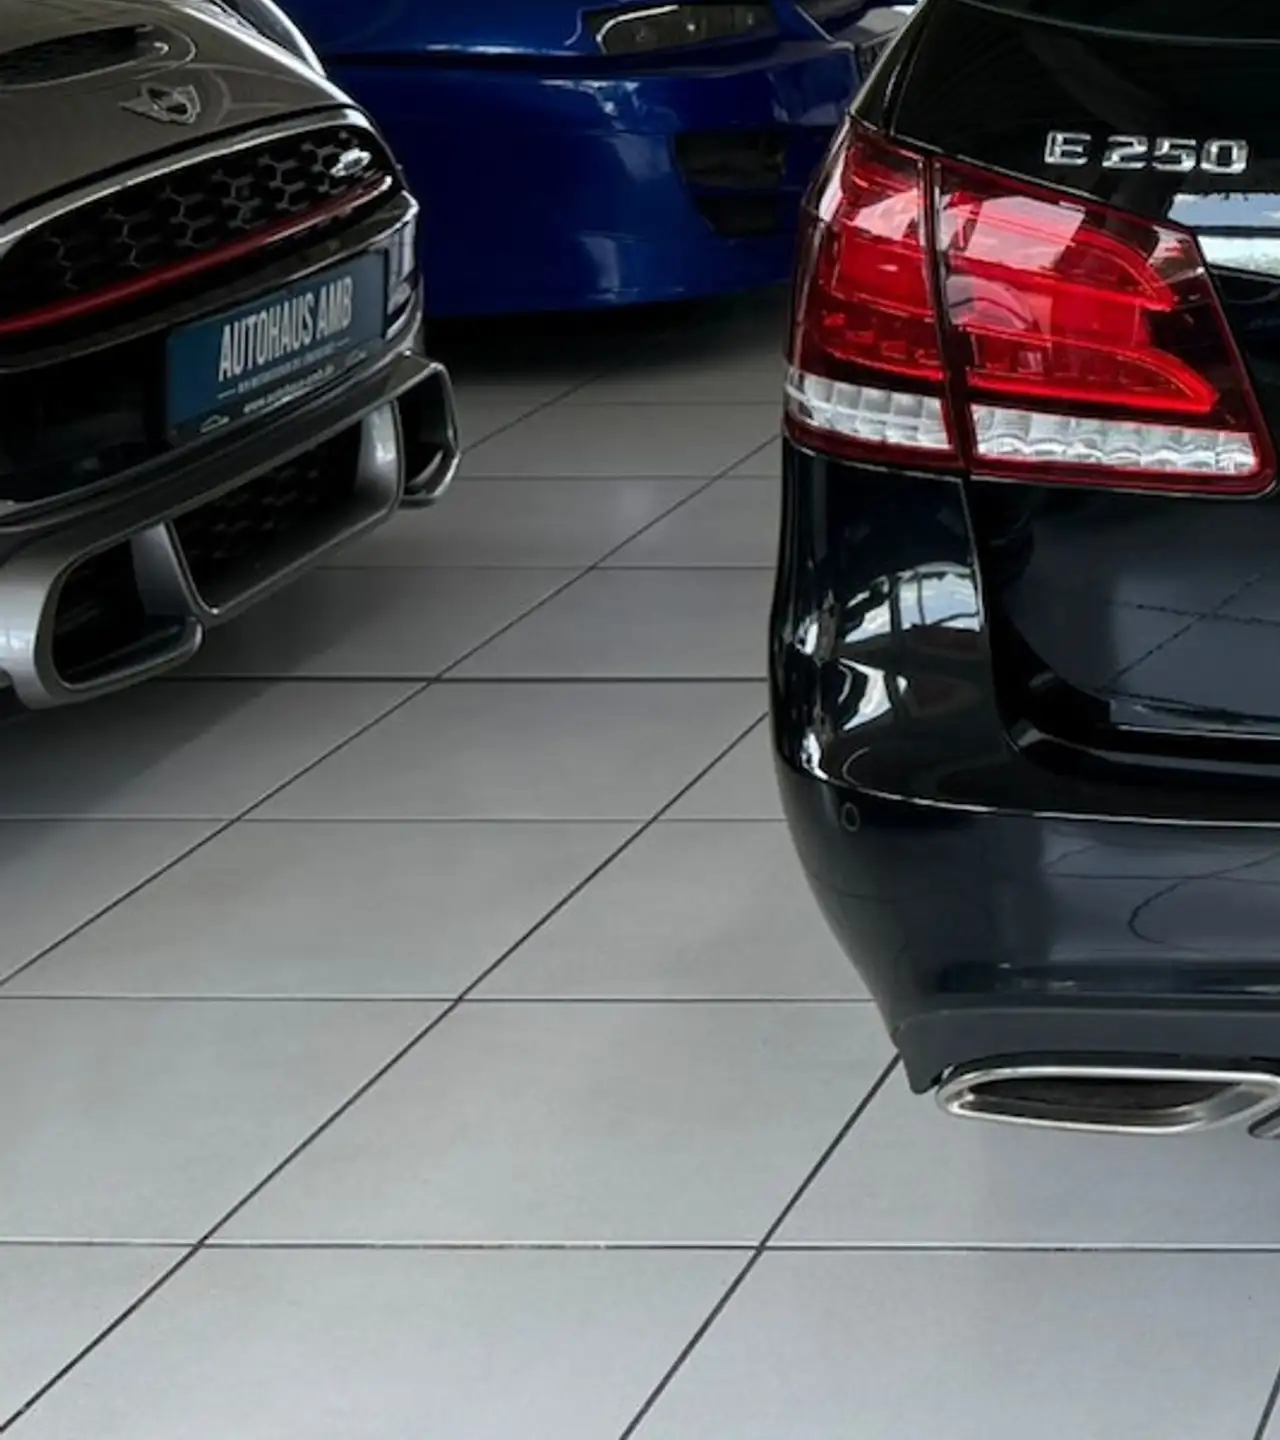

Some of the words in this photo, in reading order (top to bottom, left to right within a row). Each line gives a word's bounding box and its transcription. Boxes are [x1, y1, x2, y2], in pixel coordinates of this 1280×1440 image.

[1044, 131, 1091, 166] E
[1102, 135, 1249, 174] 250
[218, 293, 315, 382] AUTOHAUS
[316, 276, 353, 340] AMB
